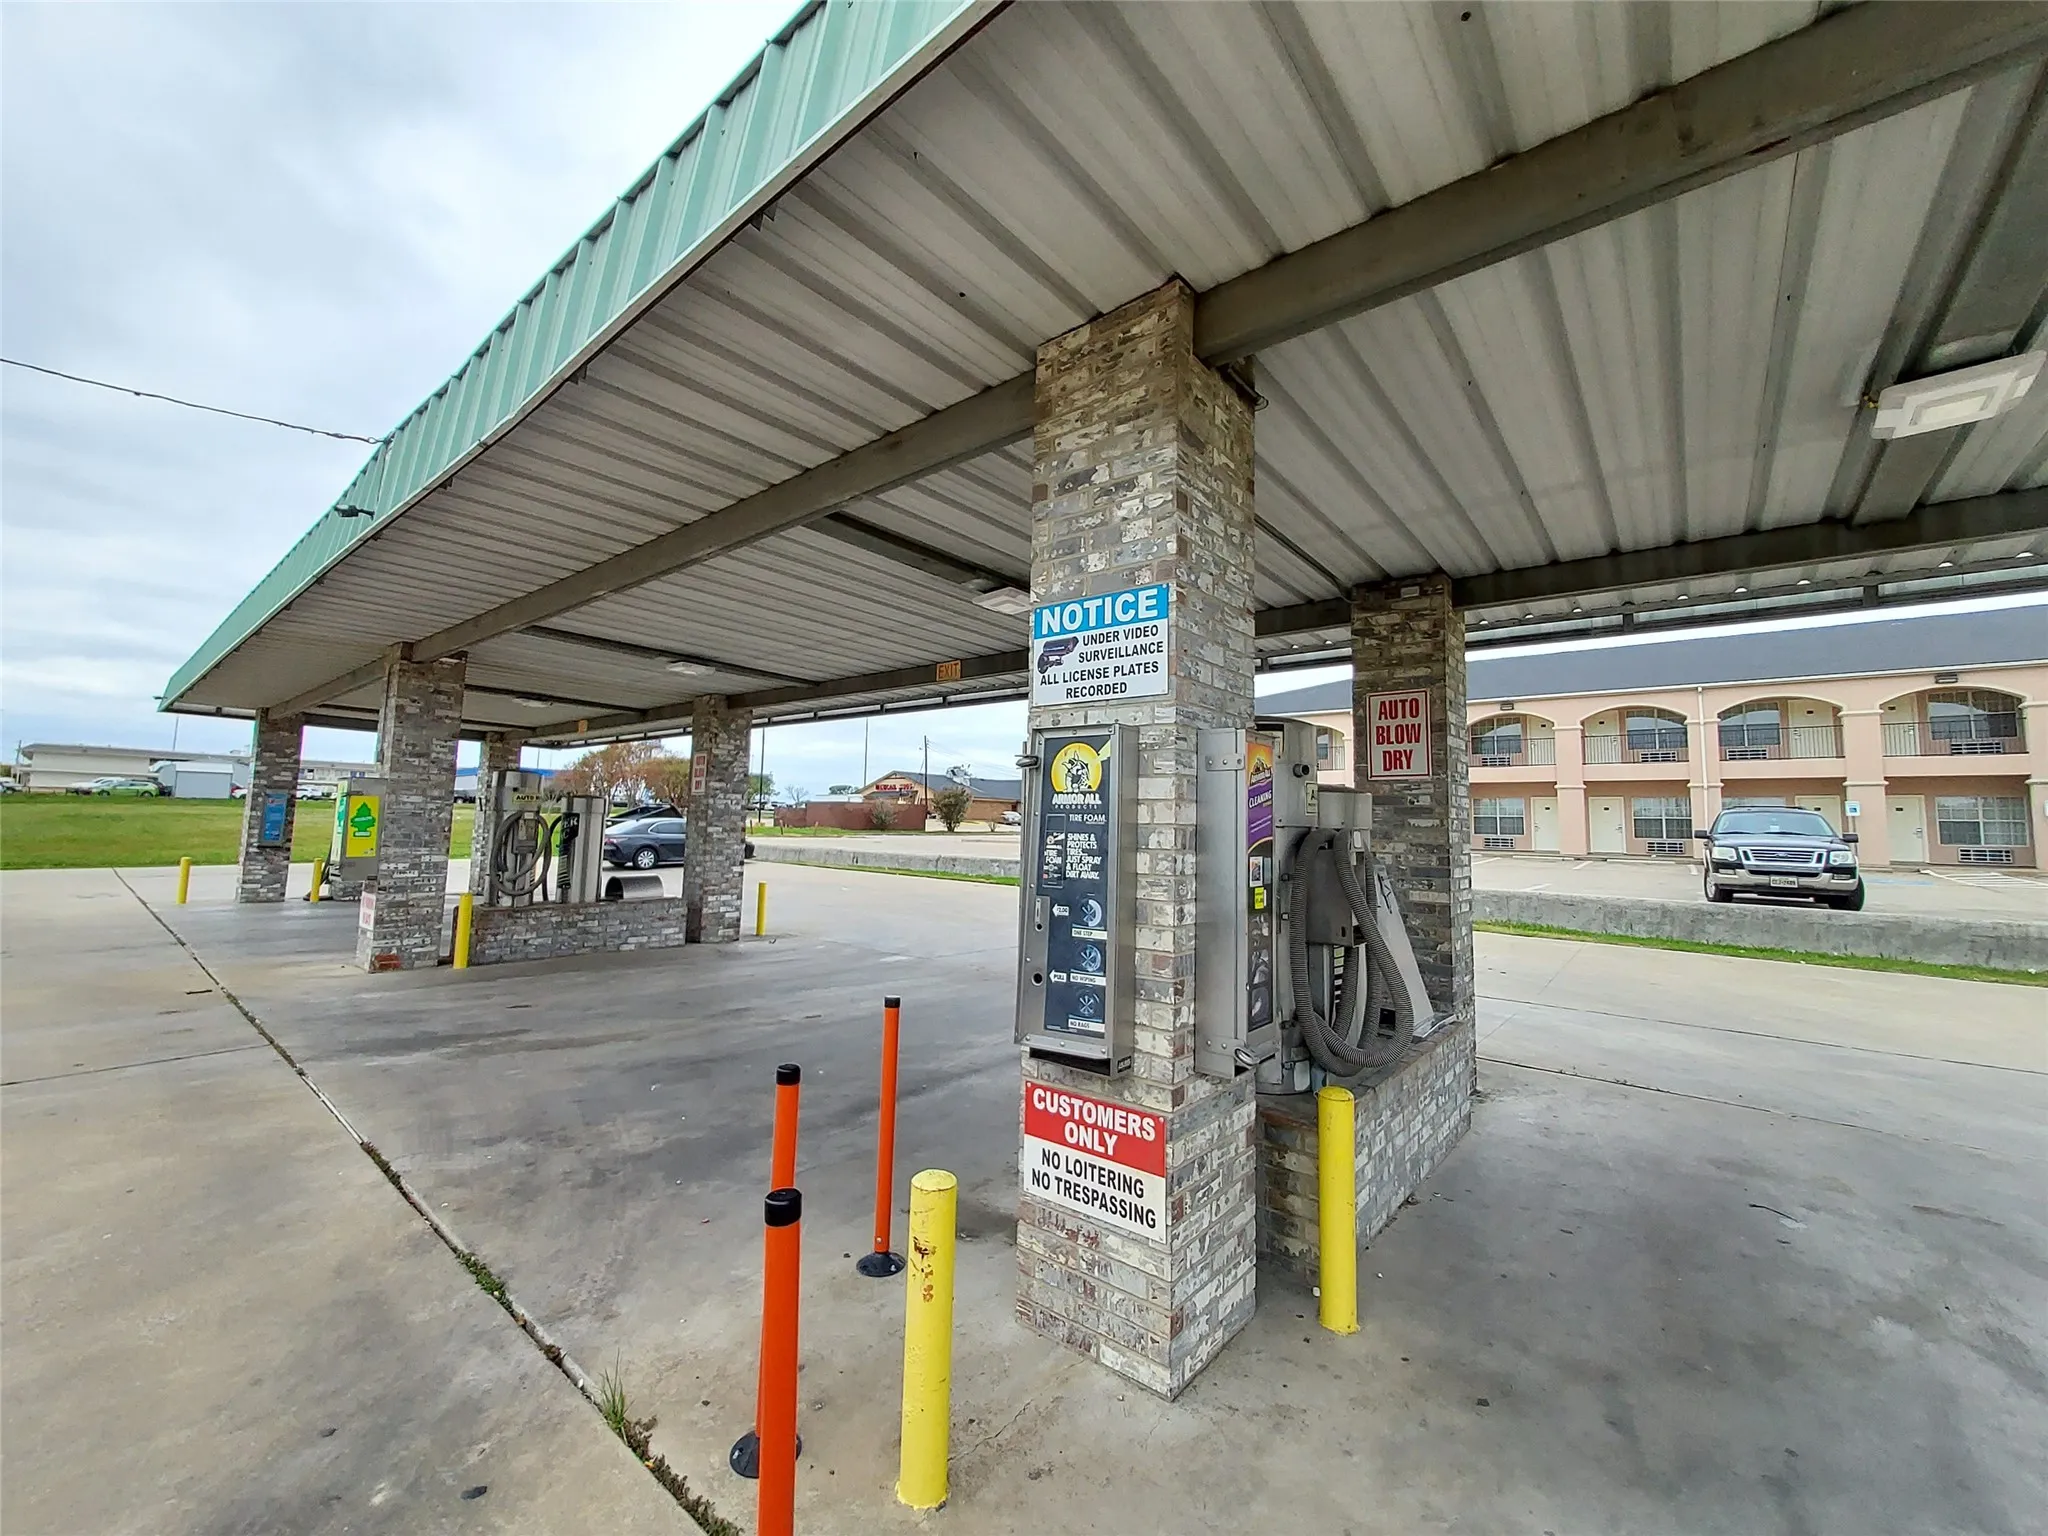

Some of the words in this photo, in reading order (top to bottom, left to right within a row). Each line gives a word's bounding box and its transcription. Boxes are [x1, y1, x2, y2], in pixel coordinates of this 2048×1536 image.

[1041, 588, 1159, 635] NOTICE
[1082, 630, 1120, 646] UNDER
[1123, 625, 1159, 640] VIDEO
[1078, 641, 1164, 663] SURVEILLANCE
[939, 662, 959, 679] EXIT
[1040, 673, 1060, 686] ALL
[1062, 666, 1110, 683] LICENSE
[1113, 661, 1159, 678] PLATES
[1066, 682, 1127, 699] RECORDED
[1378, 697, 1420, 721] AUTO
[1375, 723, 1422, 746] BLOW
[1382, 749, 1414, 772] DRY
[1085, 793, 1103, 805] ALL
[1069, 813, 1083, 822] TIRE
[1066, 840, 1098, 849] PROTECTS
[1067, 832, 1089, 841] SHINES
[1090, 833, 1096, 841] &
[1065, 855, 1081, 863] JUST
[1081, 856, 1102, 865] SPRAY
[1065, 862, 1072, 870] &
[1072, 863, 1092, 871] FLOAT
[1065, 870, 1080, 878] DIRT
[1032, 1088, 1156, 1141] CUSTOMERS
[1064, 1121, 1118, 1156] ONLY
[1042, 1147, 1061, 1170] NO
[1065, 1154, 1144, 1199] LOITERING
[1031, 1167, 1051, 1190] NO
[1054, 1176, 1156, 1229] TRESPASSING
